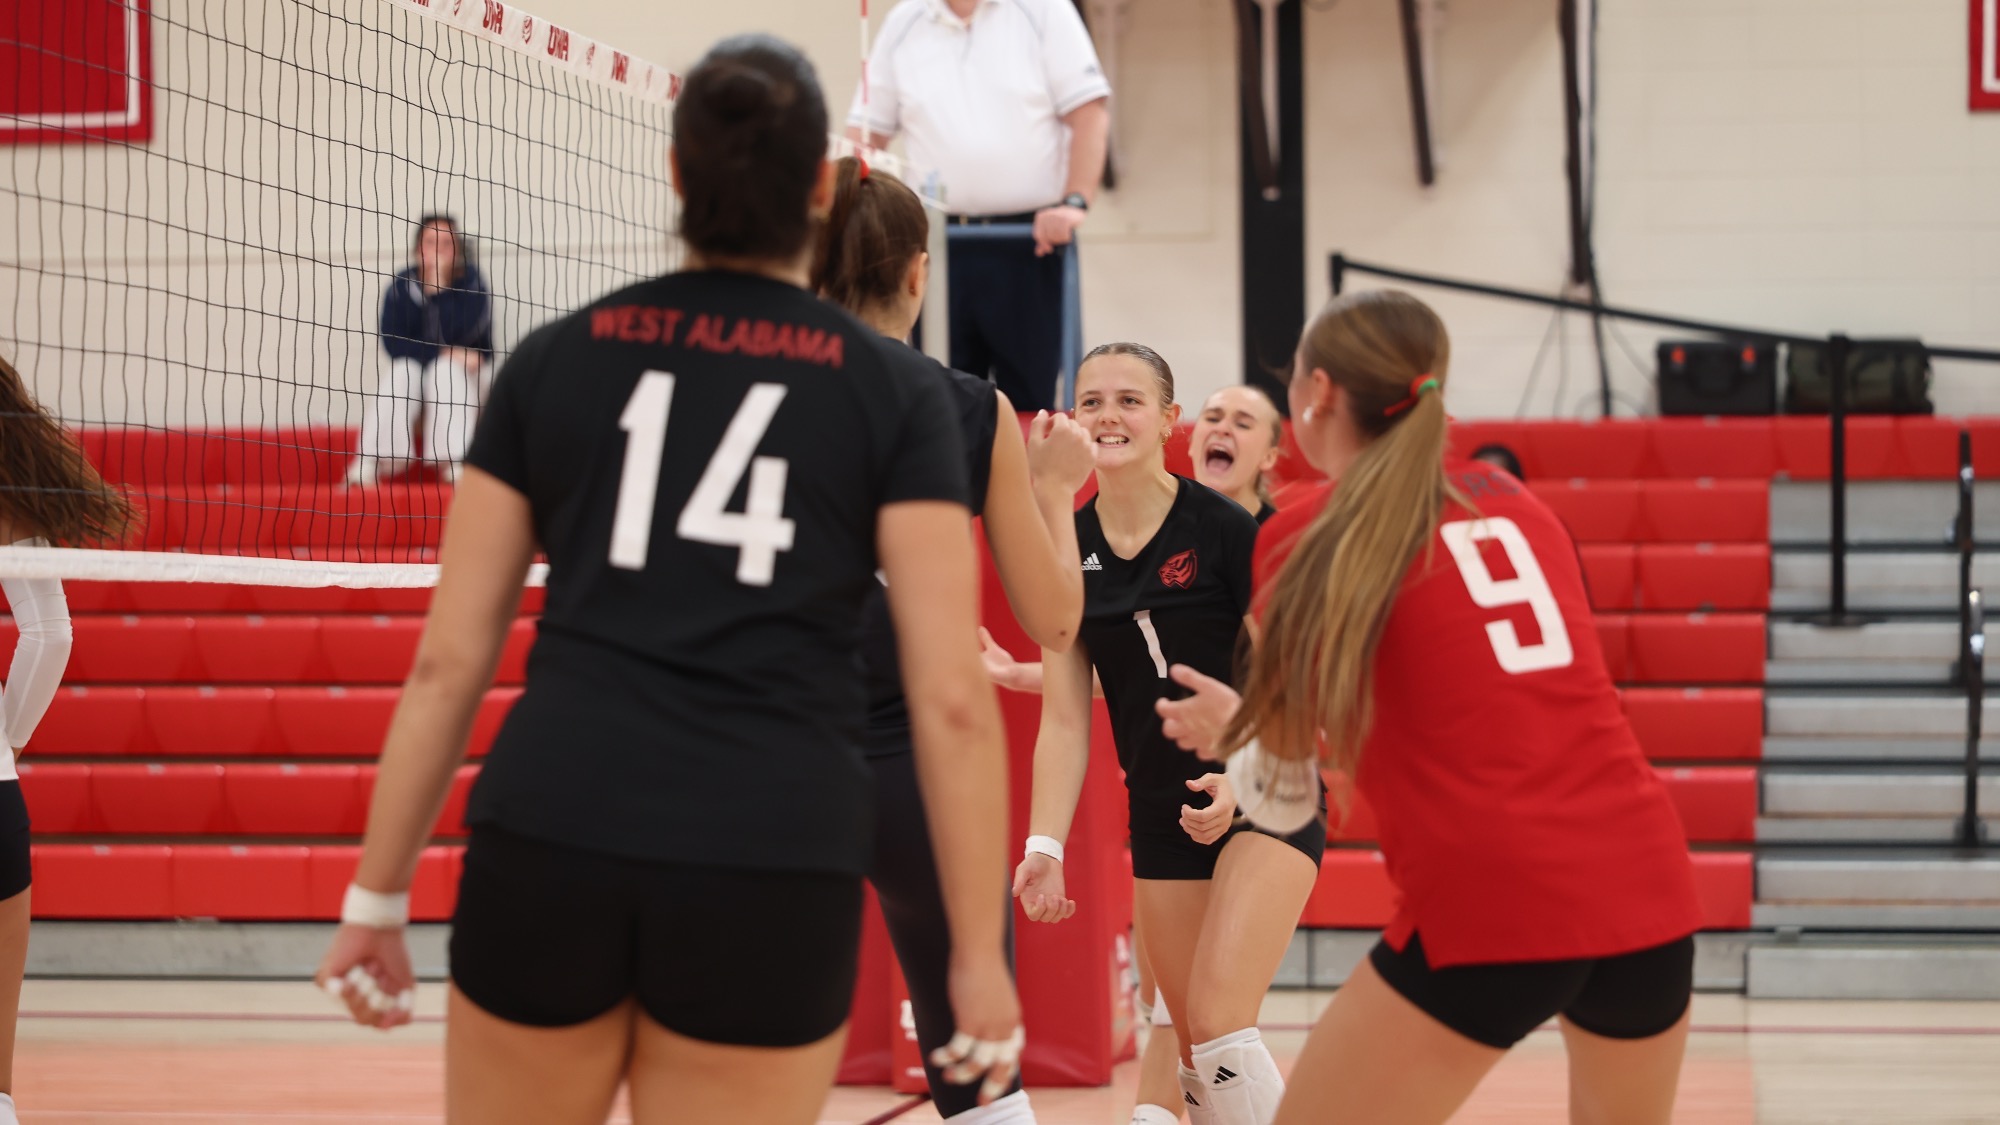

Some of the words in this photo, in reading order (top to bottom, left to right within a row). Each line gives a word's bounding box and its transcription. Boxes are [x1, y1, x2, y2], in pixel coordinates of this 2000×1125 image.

[591, 304, 683, 346] WEST
[684, 312, 844, 369] ALABAMA
[608, 368, 796, 587] 14
[1133, 609, 1168, 679] 1
[1440, 517, 1573, 674] 9
